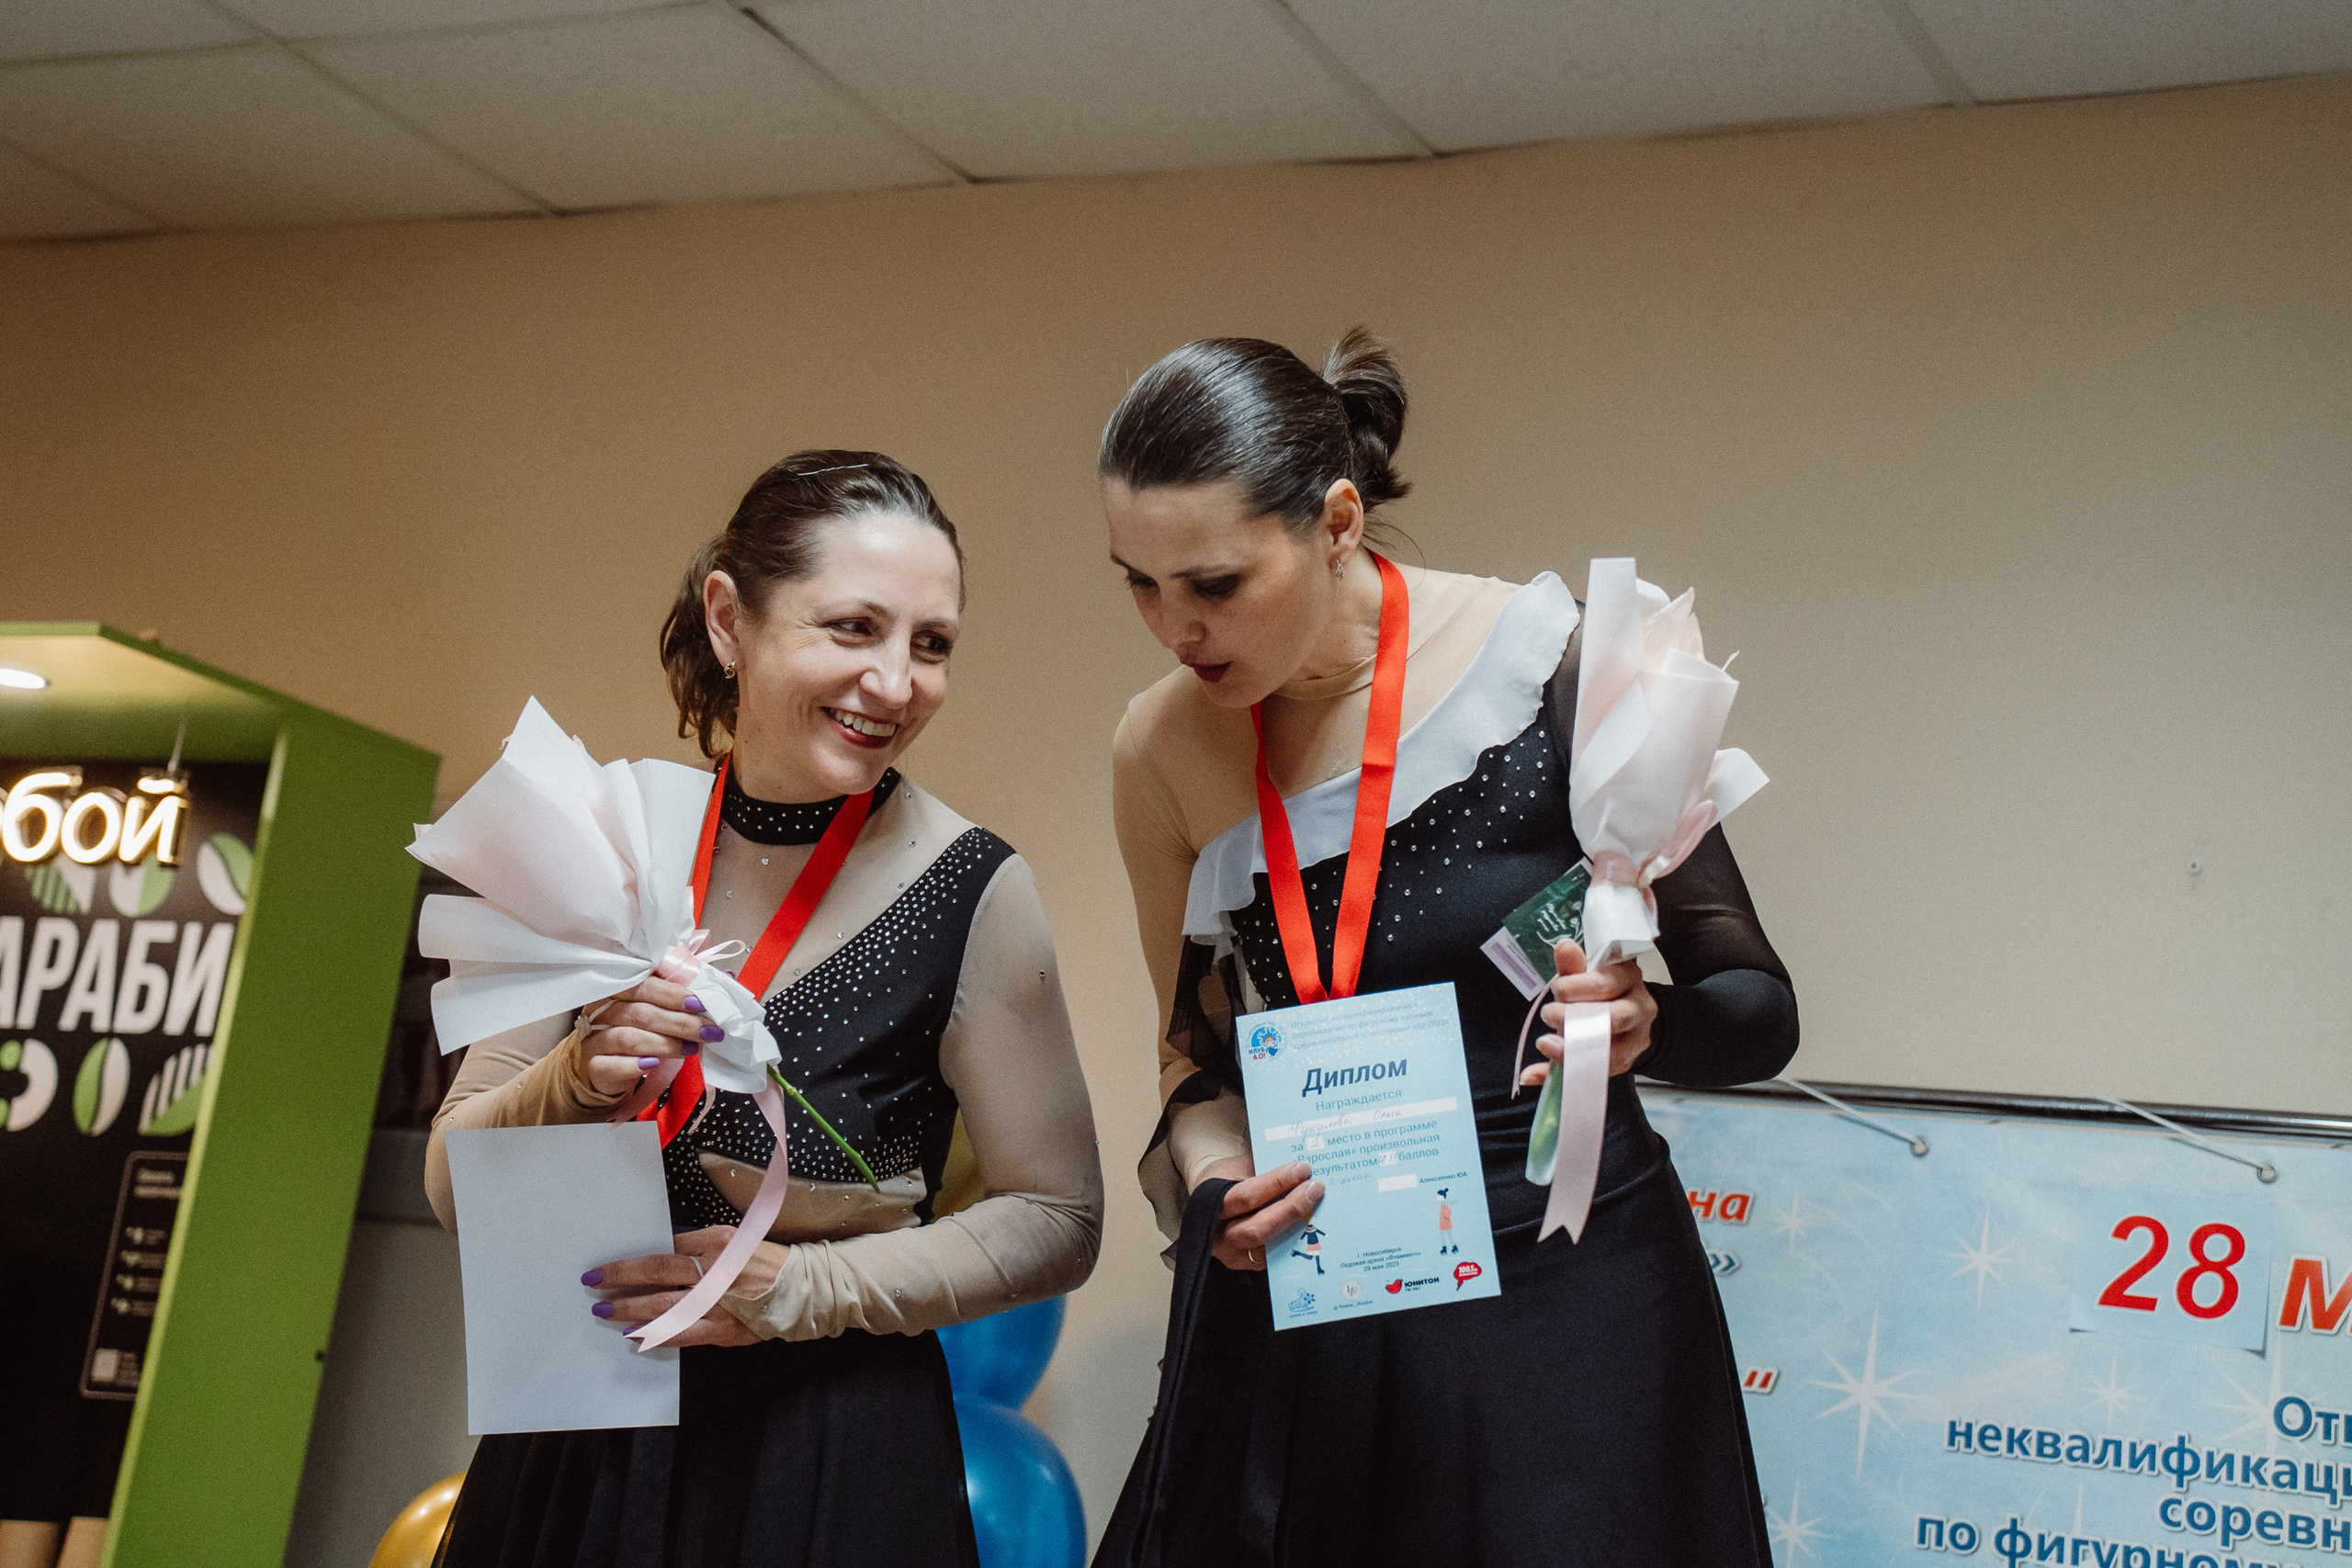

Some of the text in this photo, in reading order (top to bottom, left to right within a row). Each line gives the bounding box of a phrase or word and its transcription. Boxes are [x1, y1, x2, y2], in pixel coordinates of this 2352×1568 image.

[0, 773, 180, 863] бой
[1358, 1016, 1398, 1029] фигурному
[1294, 1040, 1317, 1051] среди
[1302, 1059, 1408, 1098] Диплом
[1316, 1088, 1402, 1111] Награждается
[1291, 1144, 1304, 1153] за
[1327, 1133, 1362, 1146] место
[1364, 1131, 1371, 1139] в
[1374, 1120, 1438, 1138] программе
[1360, 1134, 1440, 1155] произвольная
[1312, 1157, 1377, 1177] езультатом
[1398, 1147, 1439, 1162] баллов
[1340, 1260, 1365, 1269] Ледовая
[1363, 1247, 1401, 1258] Новосибирск
[2098, 1214, 2245, 1320] 28
[1404, 1277, 1440, 1288] ЮНИТОН
[2273, 1395, 2352, 1443] От
[1948, 1418, 2352, 1506] неквалификац
[1917, 1516, 1976, 1551] по
[2158, 1496, 2352, 1552] соревн
